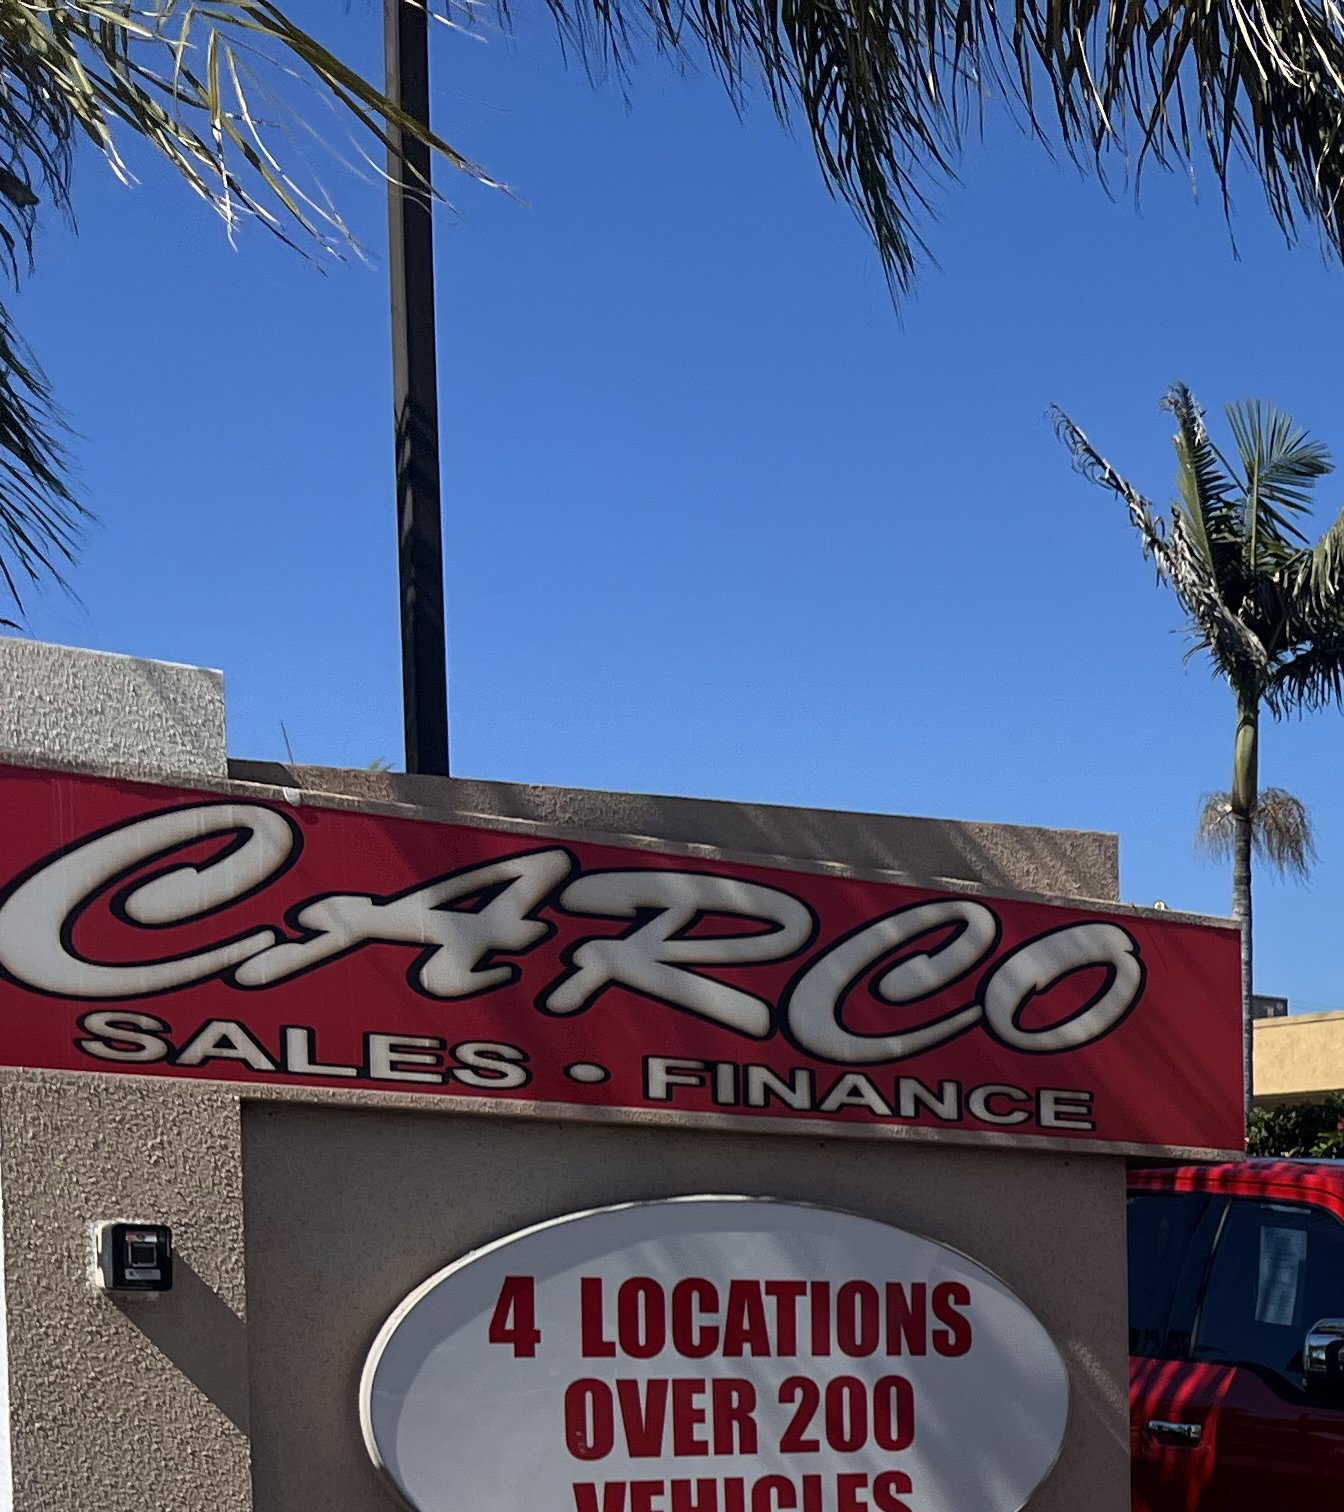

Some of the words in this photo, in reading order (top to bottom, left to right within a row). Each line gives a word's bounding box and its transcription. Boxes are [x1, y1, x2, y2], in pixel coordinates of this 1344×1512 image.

[0, 803, 1145, 1065] CARCO
[75, 1008, 530, 1090] SALES
[643, 1055, 1096, 1133] FINANCE
[488, 1275, 541, 1359] 4
[580, 1276, 974, 1359] LOCATIONS
[564, 1377, 759, 1461] OVER
[778, 1375, 916, 1453] 200
